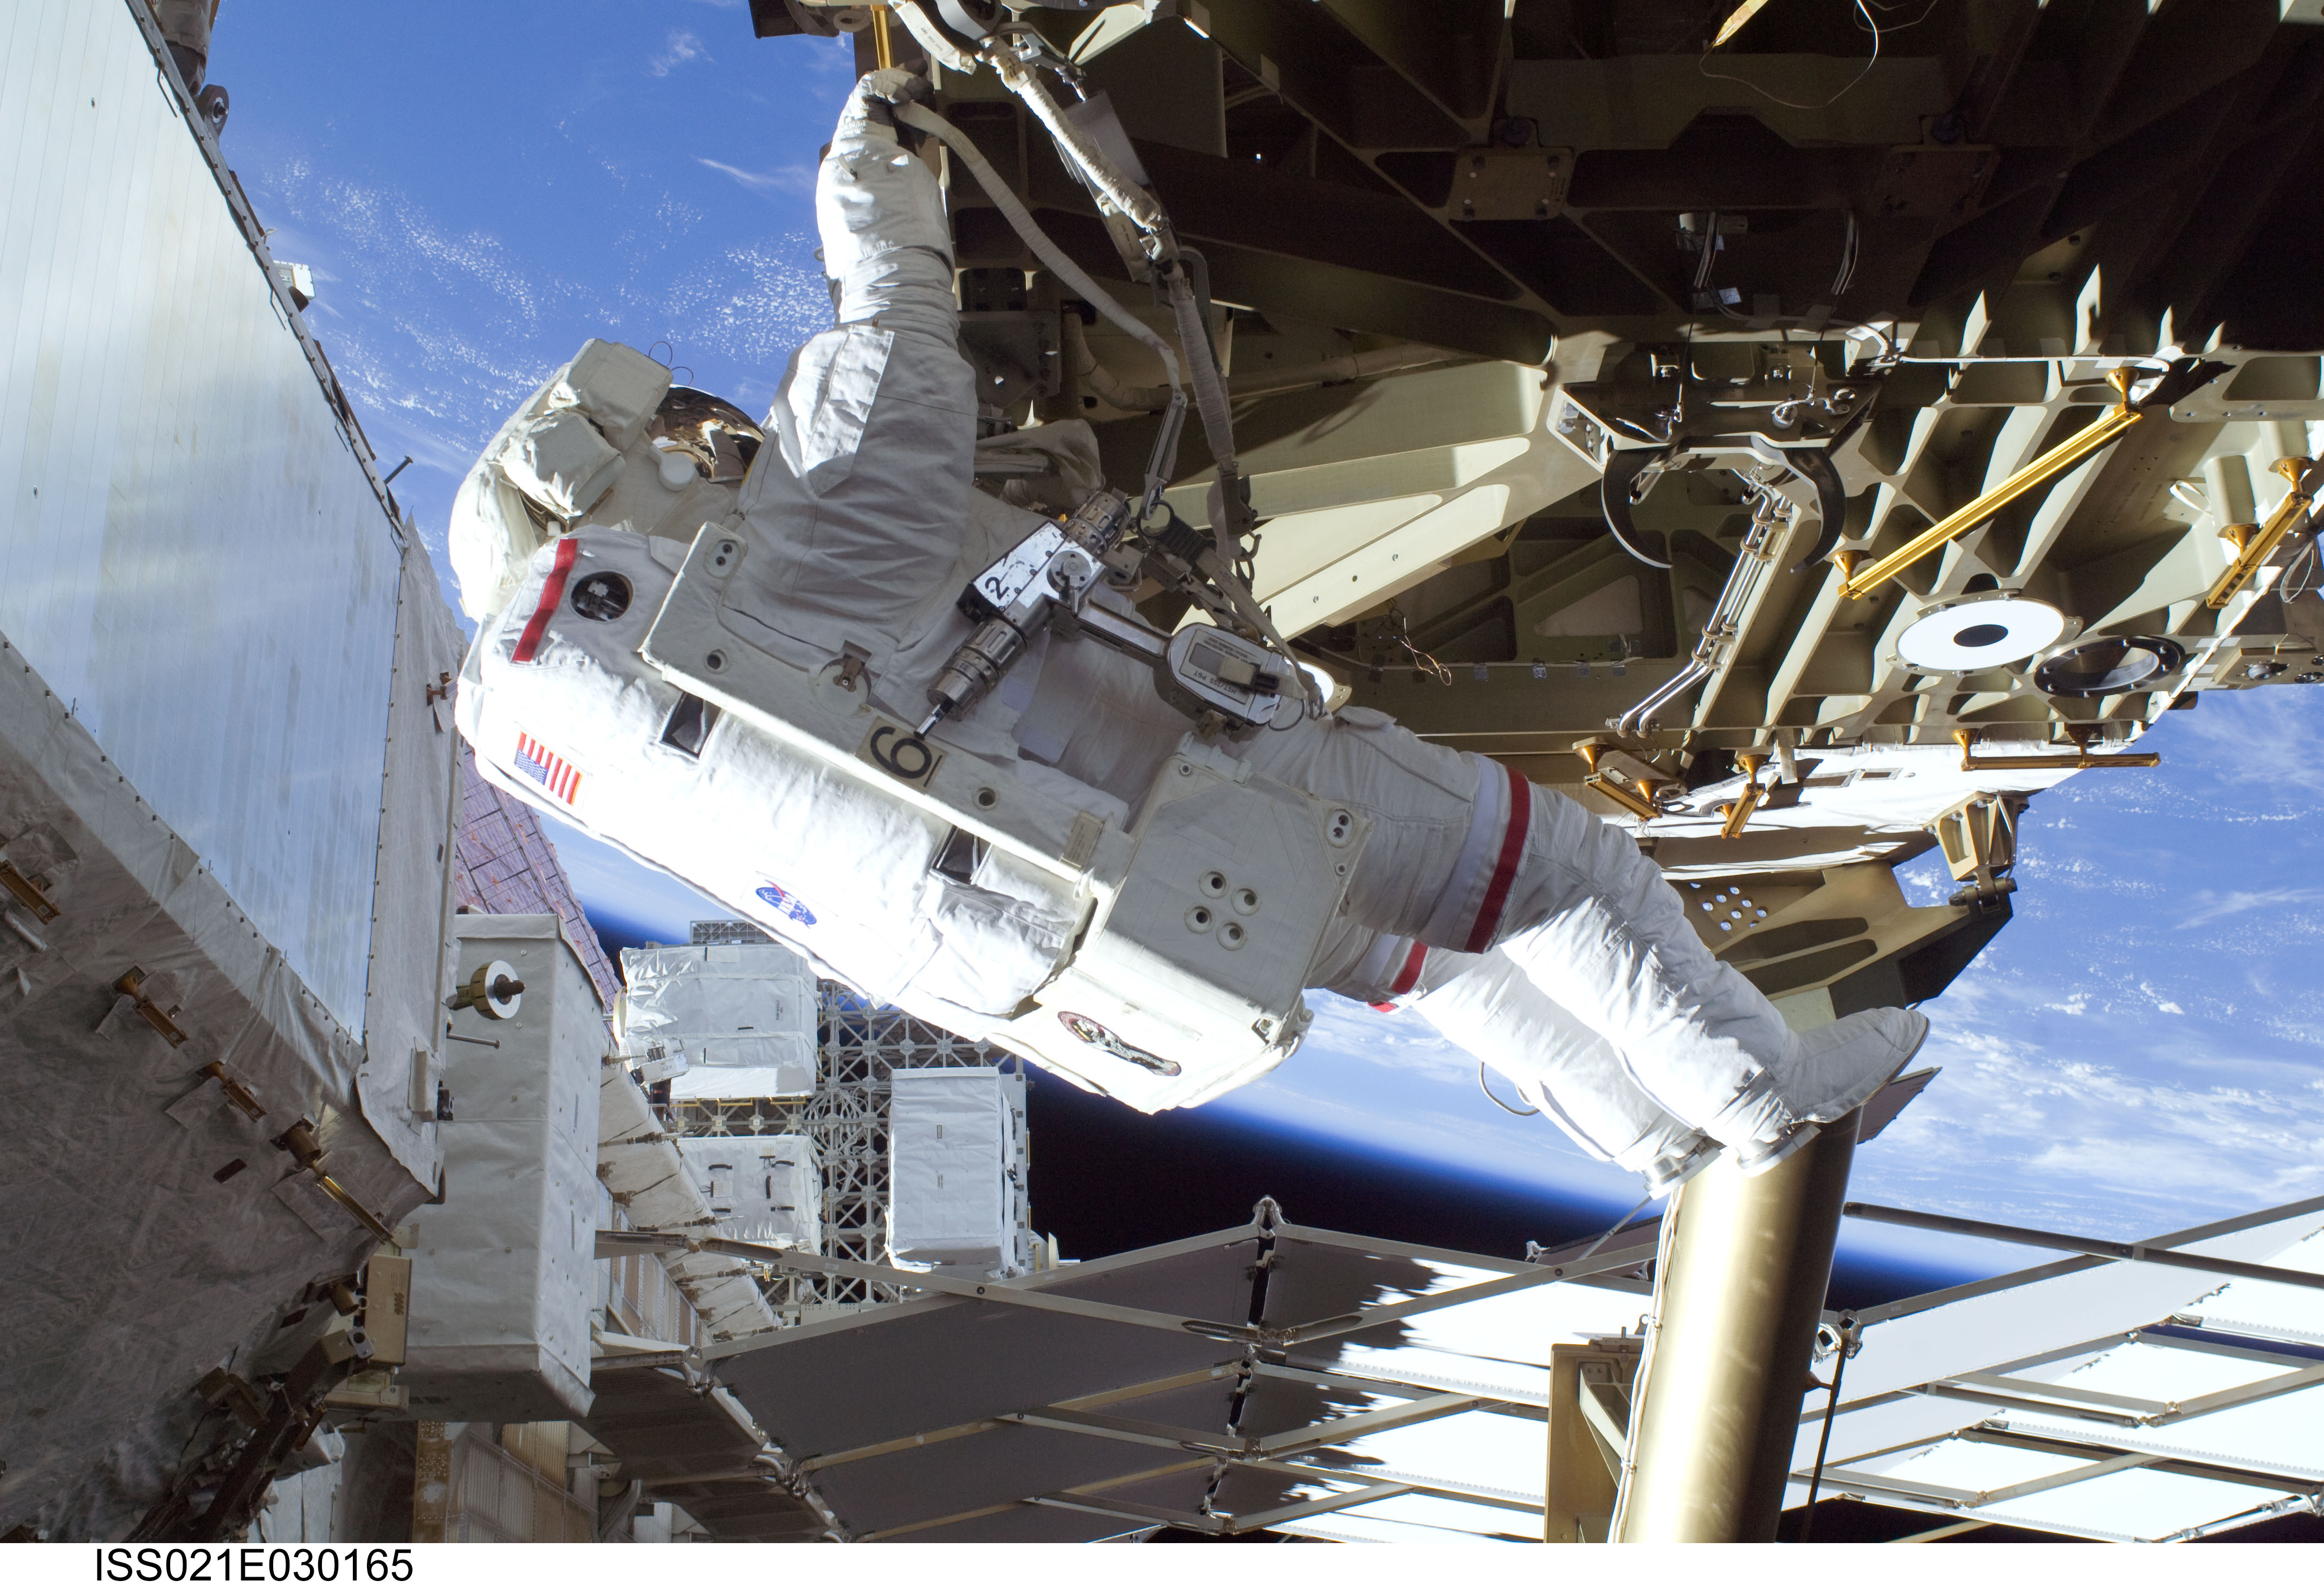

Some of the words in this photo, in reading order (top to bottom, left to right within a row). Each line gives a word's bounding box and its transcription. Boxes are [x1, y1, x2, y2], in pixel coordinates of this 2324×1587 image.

[985, 576, 1010, 600] 2
[1193, 670, 1207, 681] PGT
[1209, 678, 1237, 694] HST/ISS
[870, 726, 932, 779] 6
